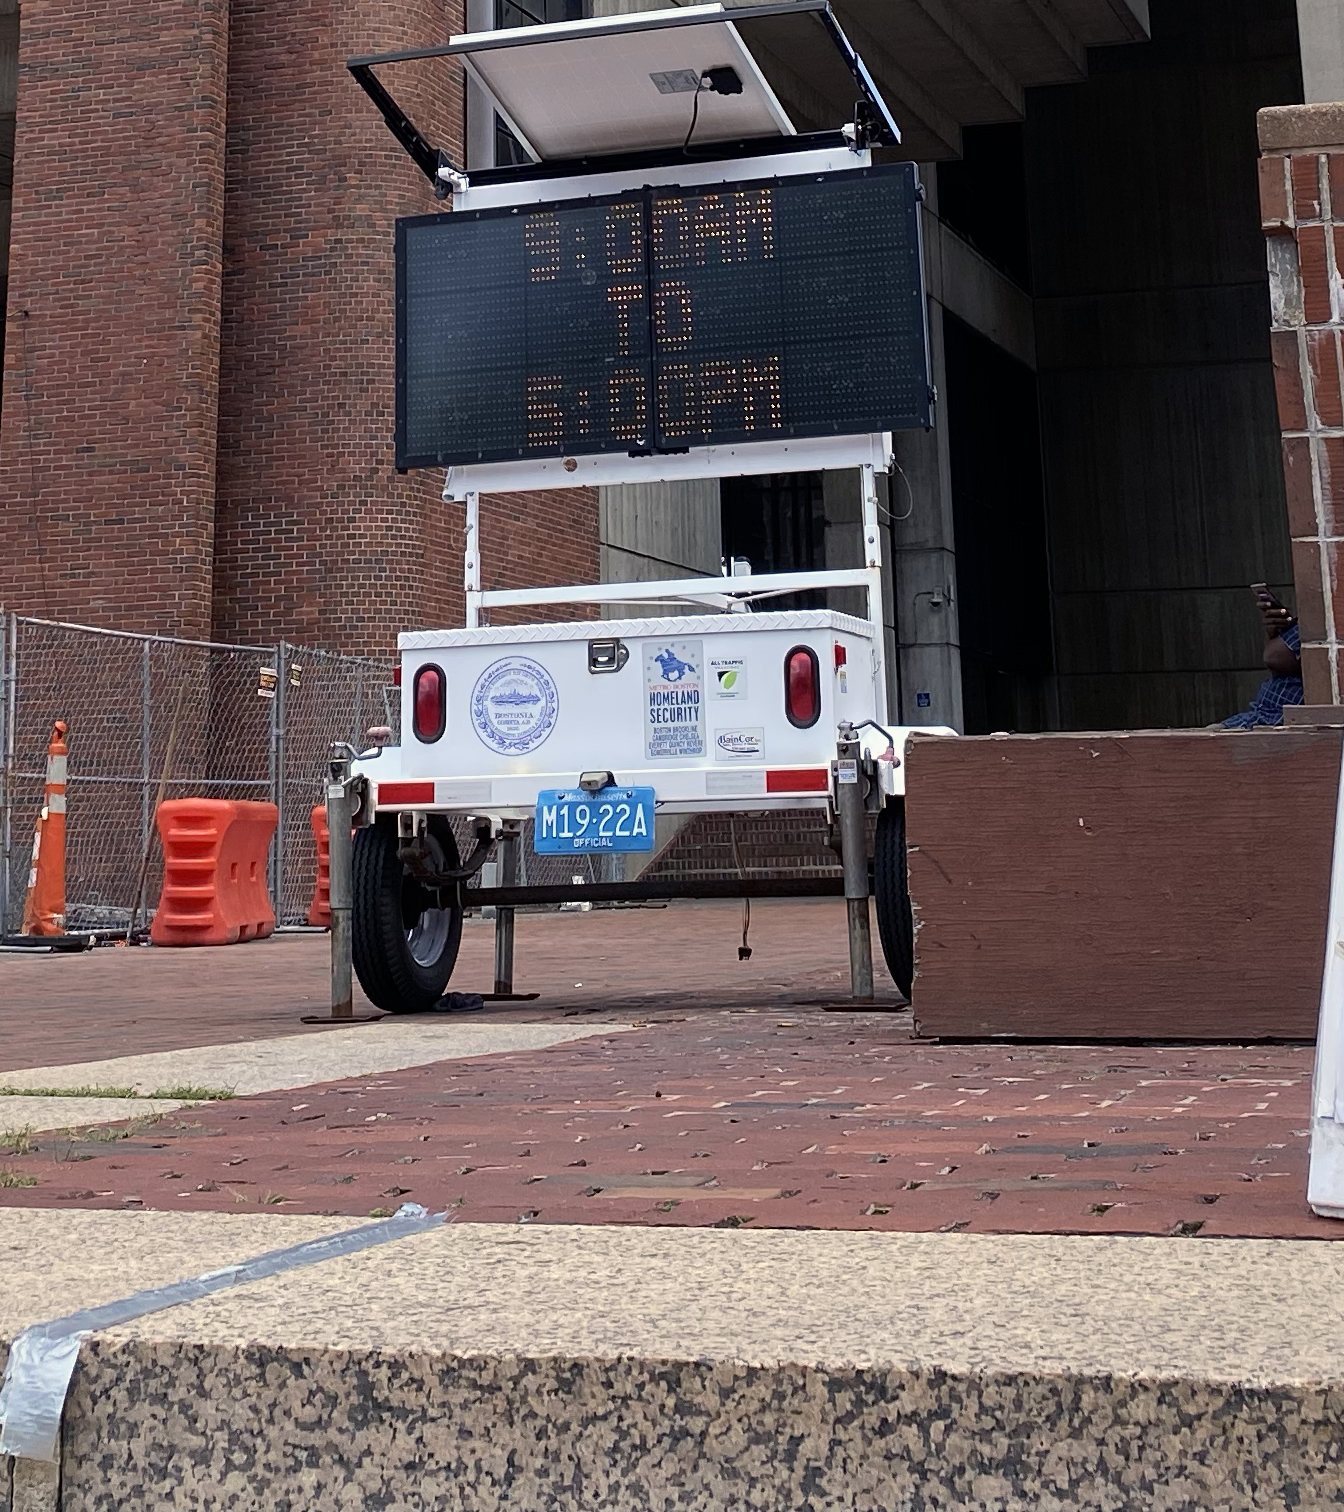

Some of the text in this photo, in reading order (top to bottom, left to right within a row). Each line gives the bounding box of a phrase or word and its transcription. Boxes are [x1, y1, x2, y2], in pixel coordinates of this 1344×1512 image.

[607, 281, 693, 355] TO
[527, 355, 782, 447] 5:00PM
[673, 682, 699, 690] BOSTON
[649, 690, 700, 706] HOMELAND
[649, 706, 700, 724] SECURITY
[573, 837, 613, 848] OFFICIAL
